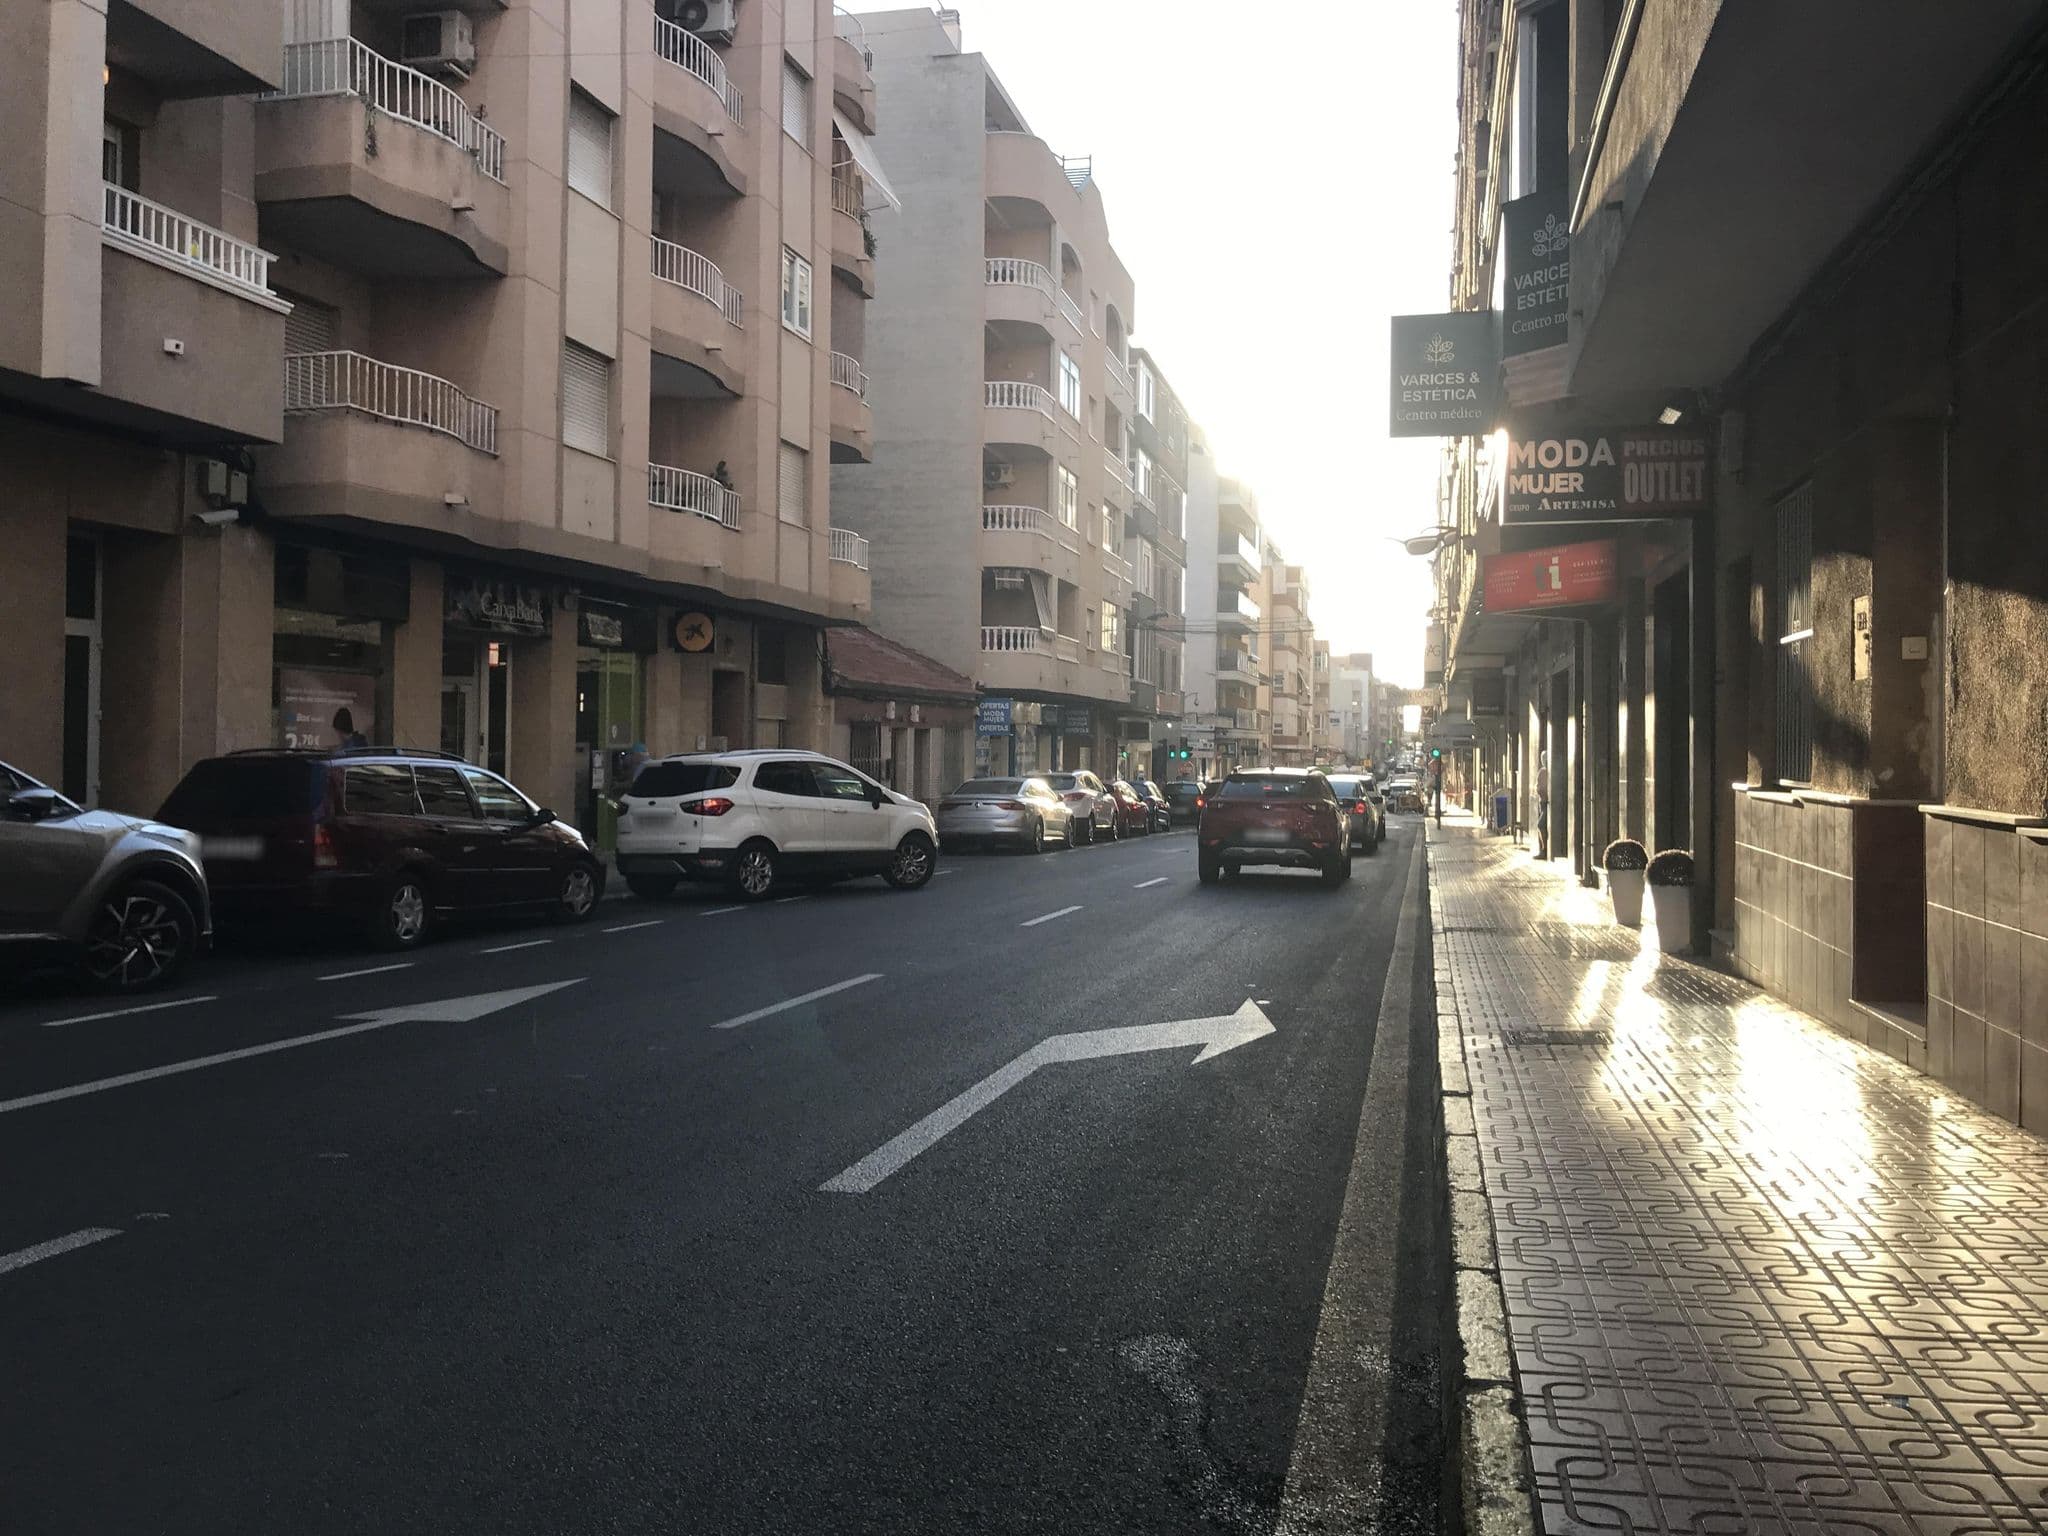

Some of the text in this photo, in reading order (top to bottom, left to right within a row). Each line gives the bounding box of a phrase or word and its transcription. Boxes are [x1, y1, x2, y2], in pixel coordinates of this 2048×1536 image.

[1512, 315, 1552, 334] Centro
[1400, 371, 1481, 387] VARICES &
[1403, 386, 1477, 402] ESTÉTICA
[1396, 406, 1482, 421] Centro médico
[1509, 438, 1616, 469] MODA
[1623, 440, 1705, 457] PRECIOS
[1509, 472, 1584, 495] MUJER
[1624, 461, 1704, 504] OUTLET
[1537, 498, 1616, 511] ARTEMISA
[480, 591, 544, 625] CaixaBank
[979, 702, 1010, 710] OFERTAS
[979, 724, 1009, 732] OFERTAS
